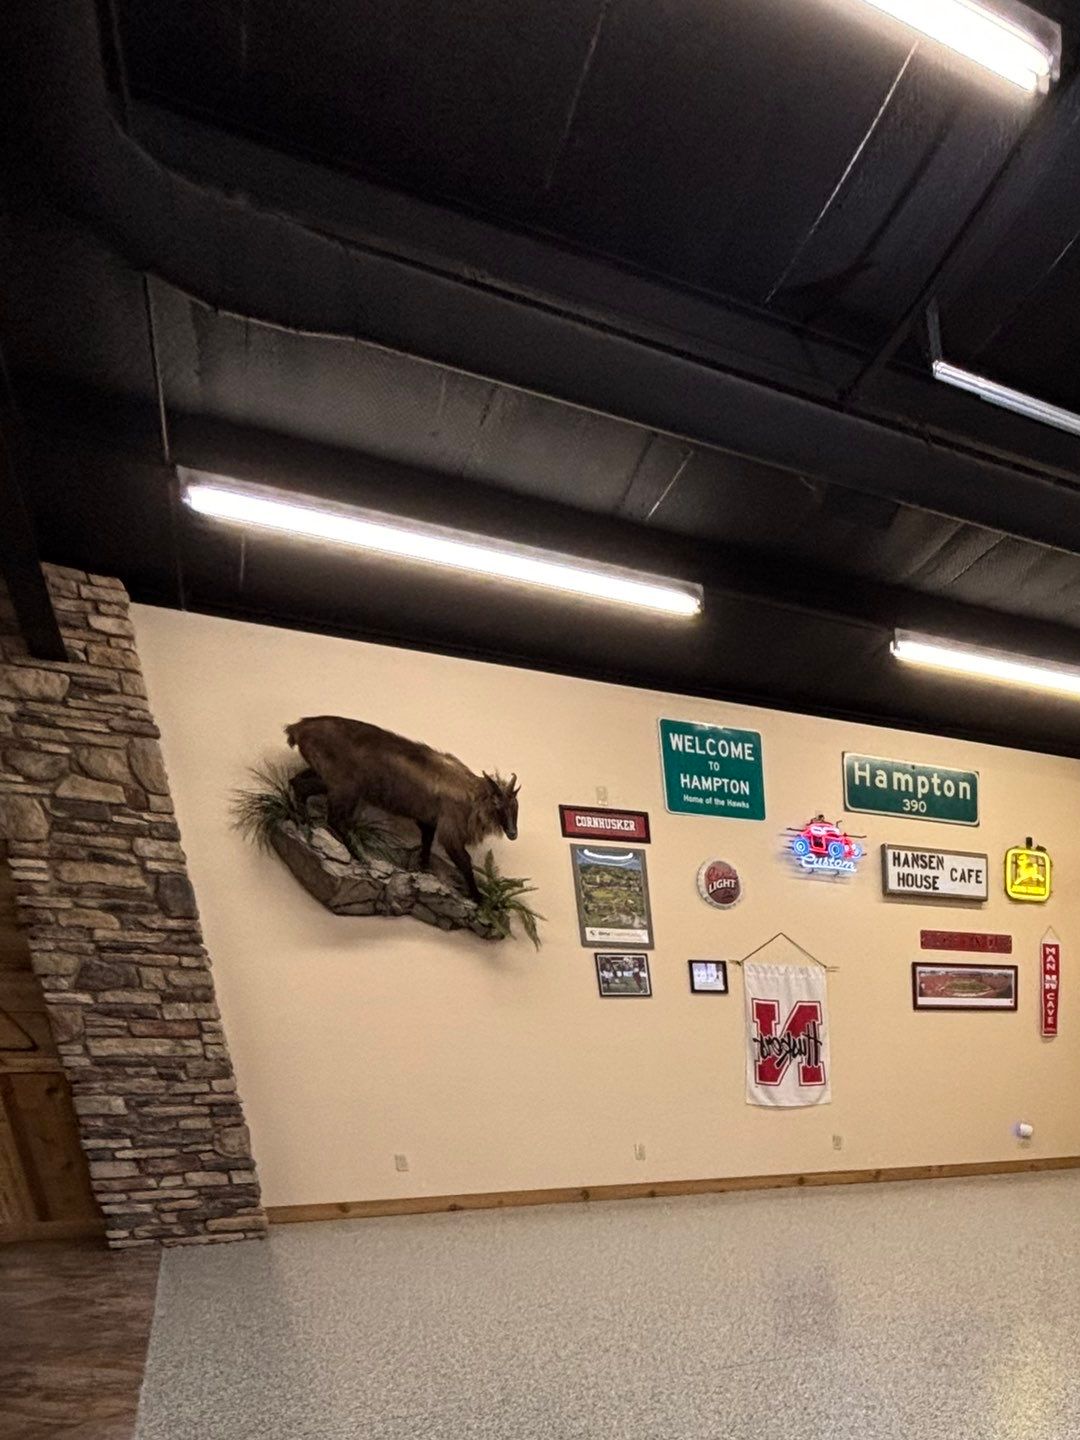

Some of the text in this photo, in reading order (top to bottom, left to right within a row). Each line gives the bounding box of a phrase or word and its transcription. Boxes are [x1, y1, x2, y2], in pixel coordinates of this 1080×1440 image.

[669, 732, 755, 761] WELCOME
[708, 761, 720, 771] TO
[680, 773, 750, 795] HAMPTON
[853, 761, 971, 800] Hampton
[683, 794, 704, 803] Home
[714, 797, 725, 806] the
[727, 799, 750, 809] Hawks
[902, 798, 927, 813] 390
[575, 815, 636, 832] CORNHUSKER
[801, 853, 857, 873] Custom
[892, 851, 945, 871] HANSEN
[897, 871, 940, 891] HOUSE
[950, 867, 983, 884] CAFE
[708, 878, 737, 894] LIGHT
[1045, 947, 1056, 971] MAN
[1046, 992, 1056, 1025] CAVE
